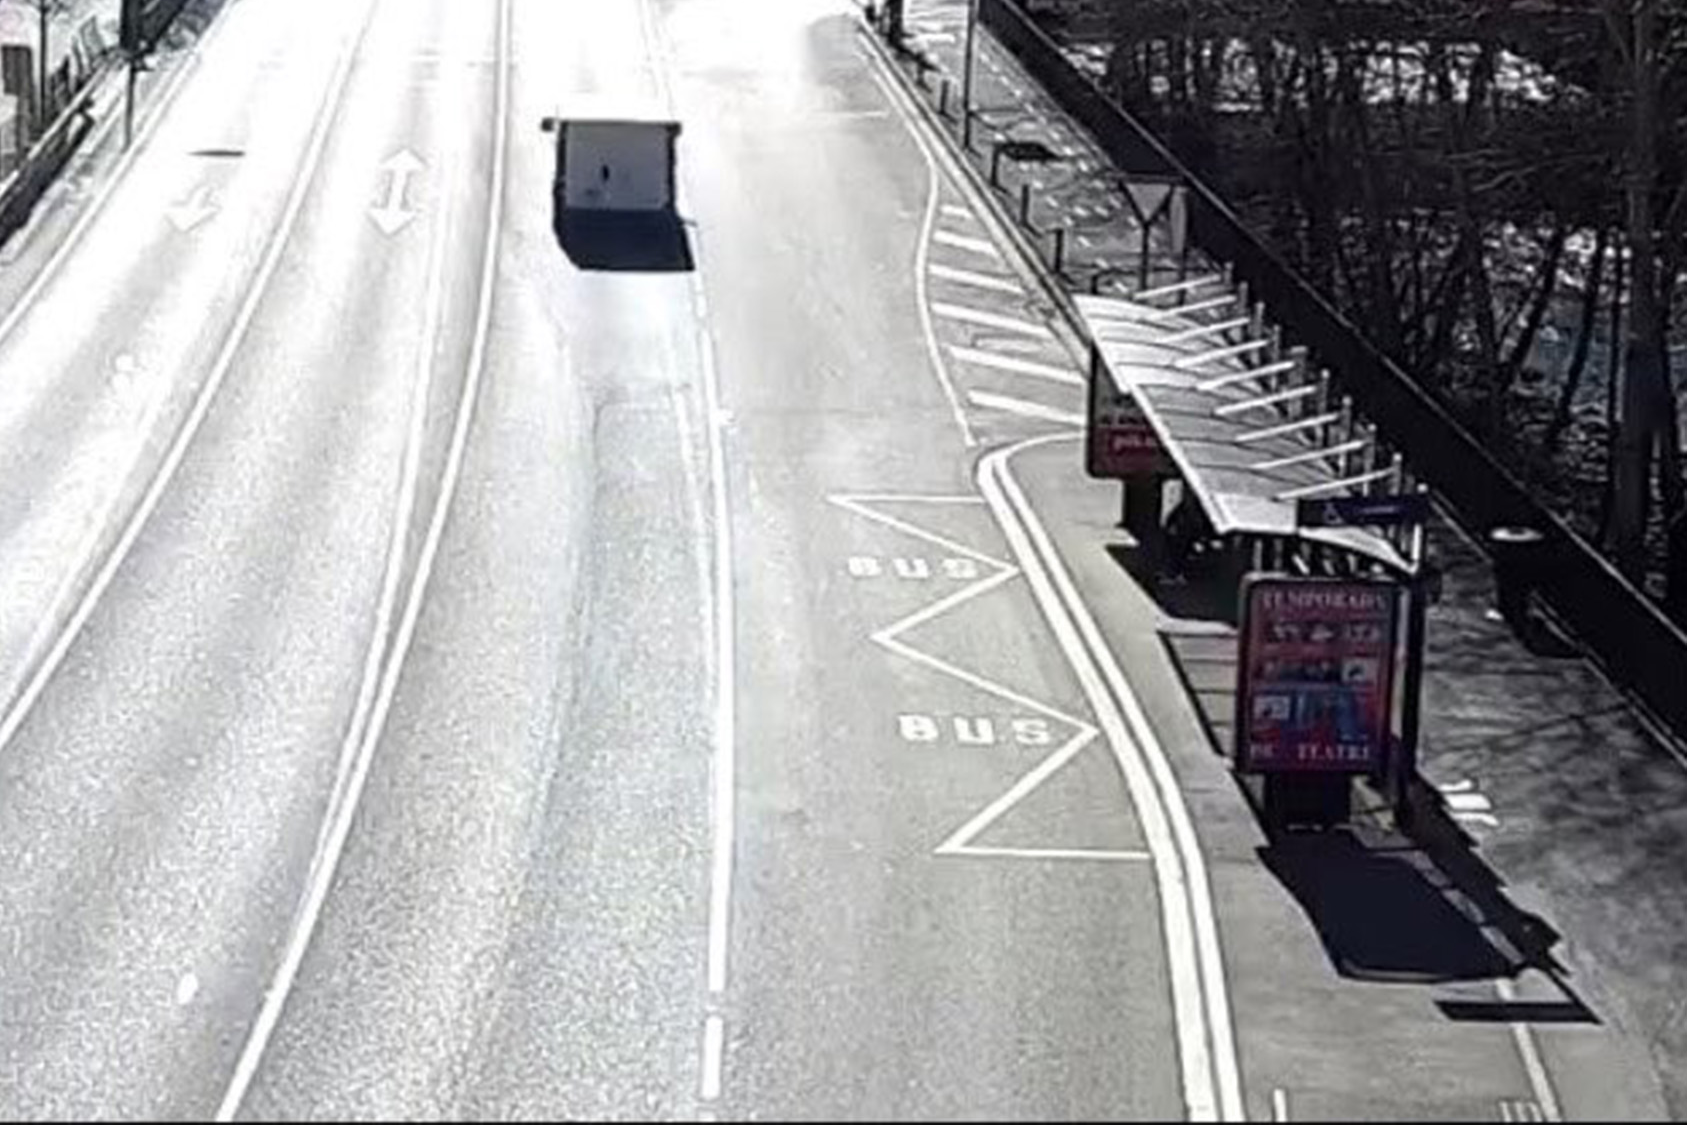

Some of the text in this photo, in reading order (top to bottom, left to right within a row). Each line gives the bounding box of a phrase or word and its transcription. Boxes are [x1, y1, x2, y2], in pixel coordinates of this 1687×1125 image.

[846, 556, 978, 579] BUS
[1262, 591, 1387, 609] TEMPORADA
[898, 714, 1051, 745] BUS
[1297, 743, 1370, 760] TEATRE
